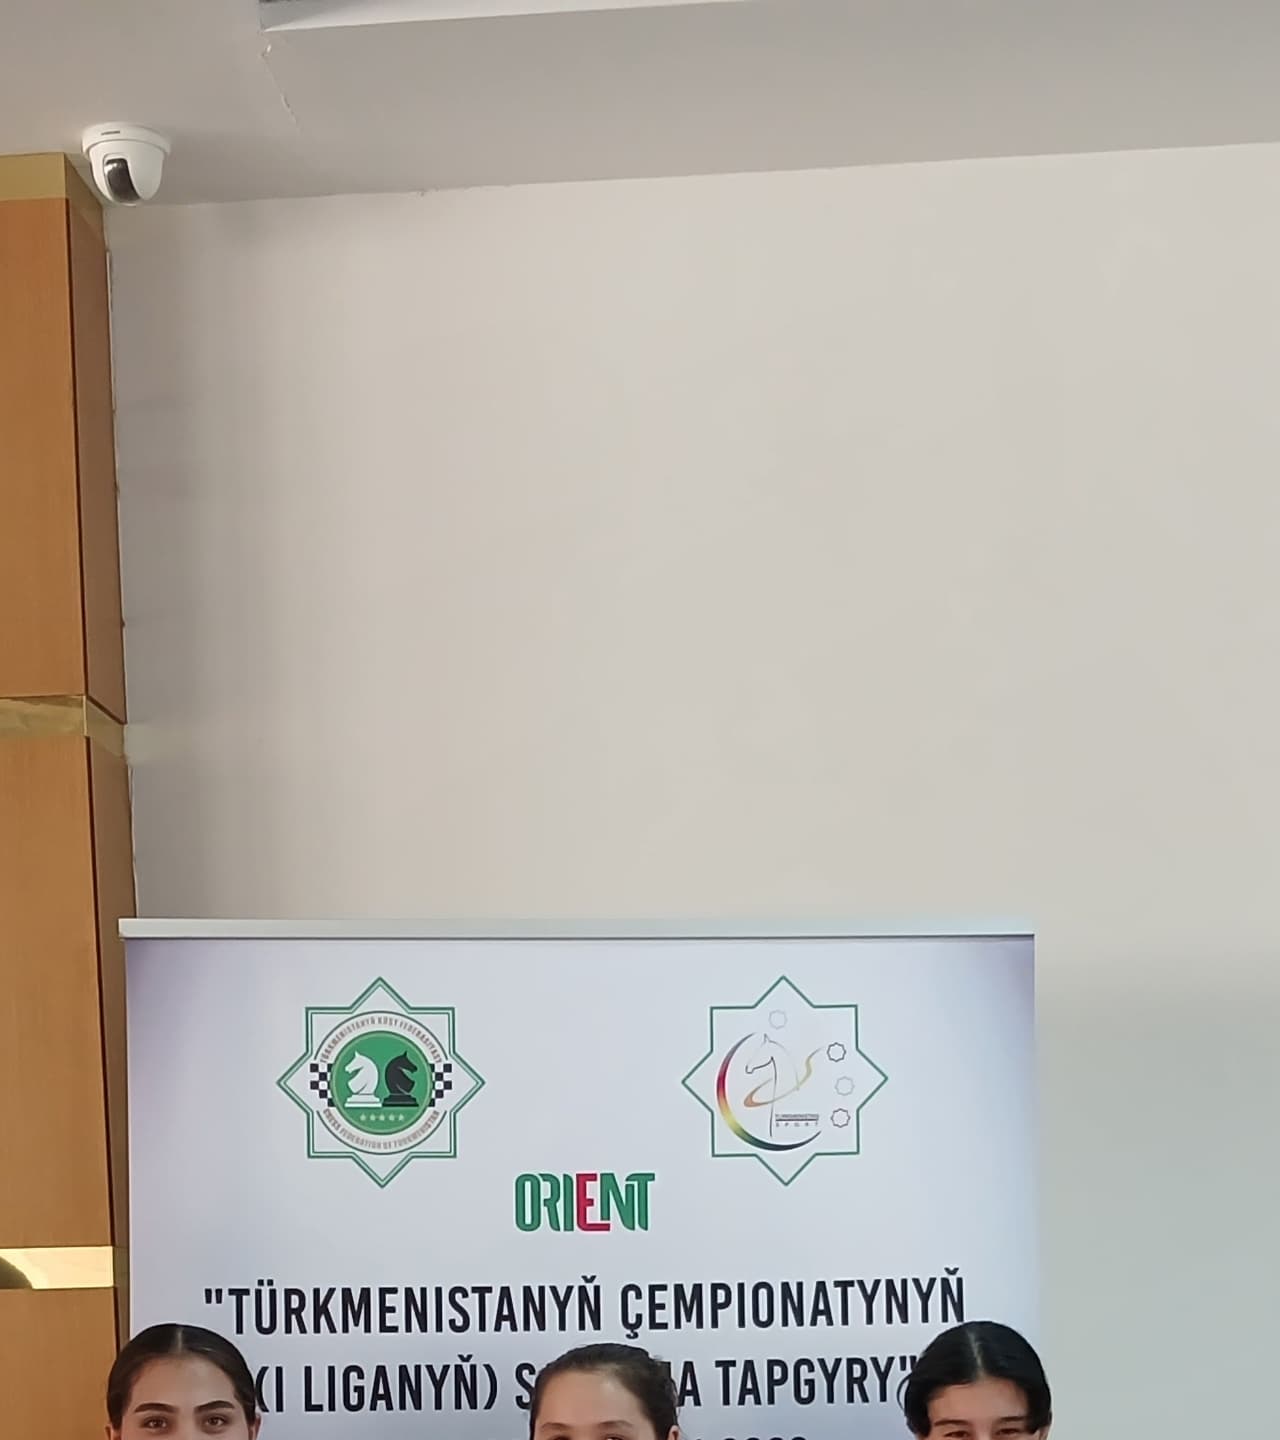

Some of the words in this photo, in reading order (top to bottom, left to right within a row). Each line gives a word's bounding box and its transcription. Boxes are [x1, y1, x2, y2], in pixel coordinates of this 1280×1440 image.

[514, 1172, 655, 1232] ORIENT
[204, 1275, 602, 1335] "TÜRKMENISTANYŇ
[620, 1267, 965, 1339] ÇEMPIONATYNYŇ
[304, 1354, 499, 1413] LIGANYŇ)
